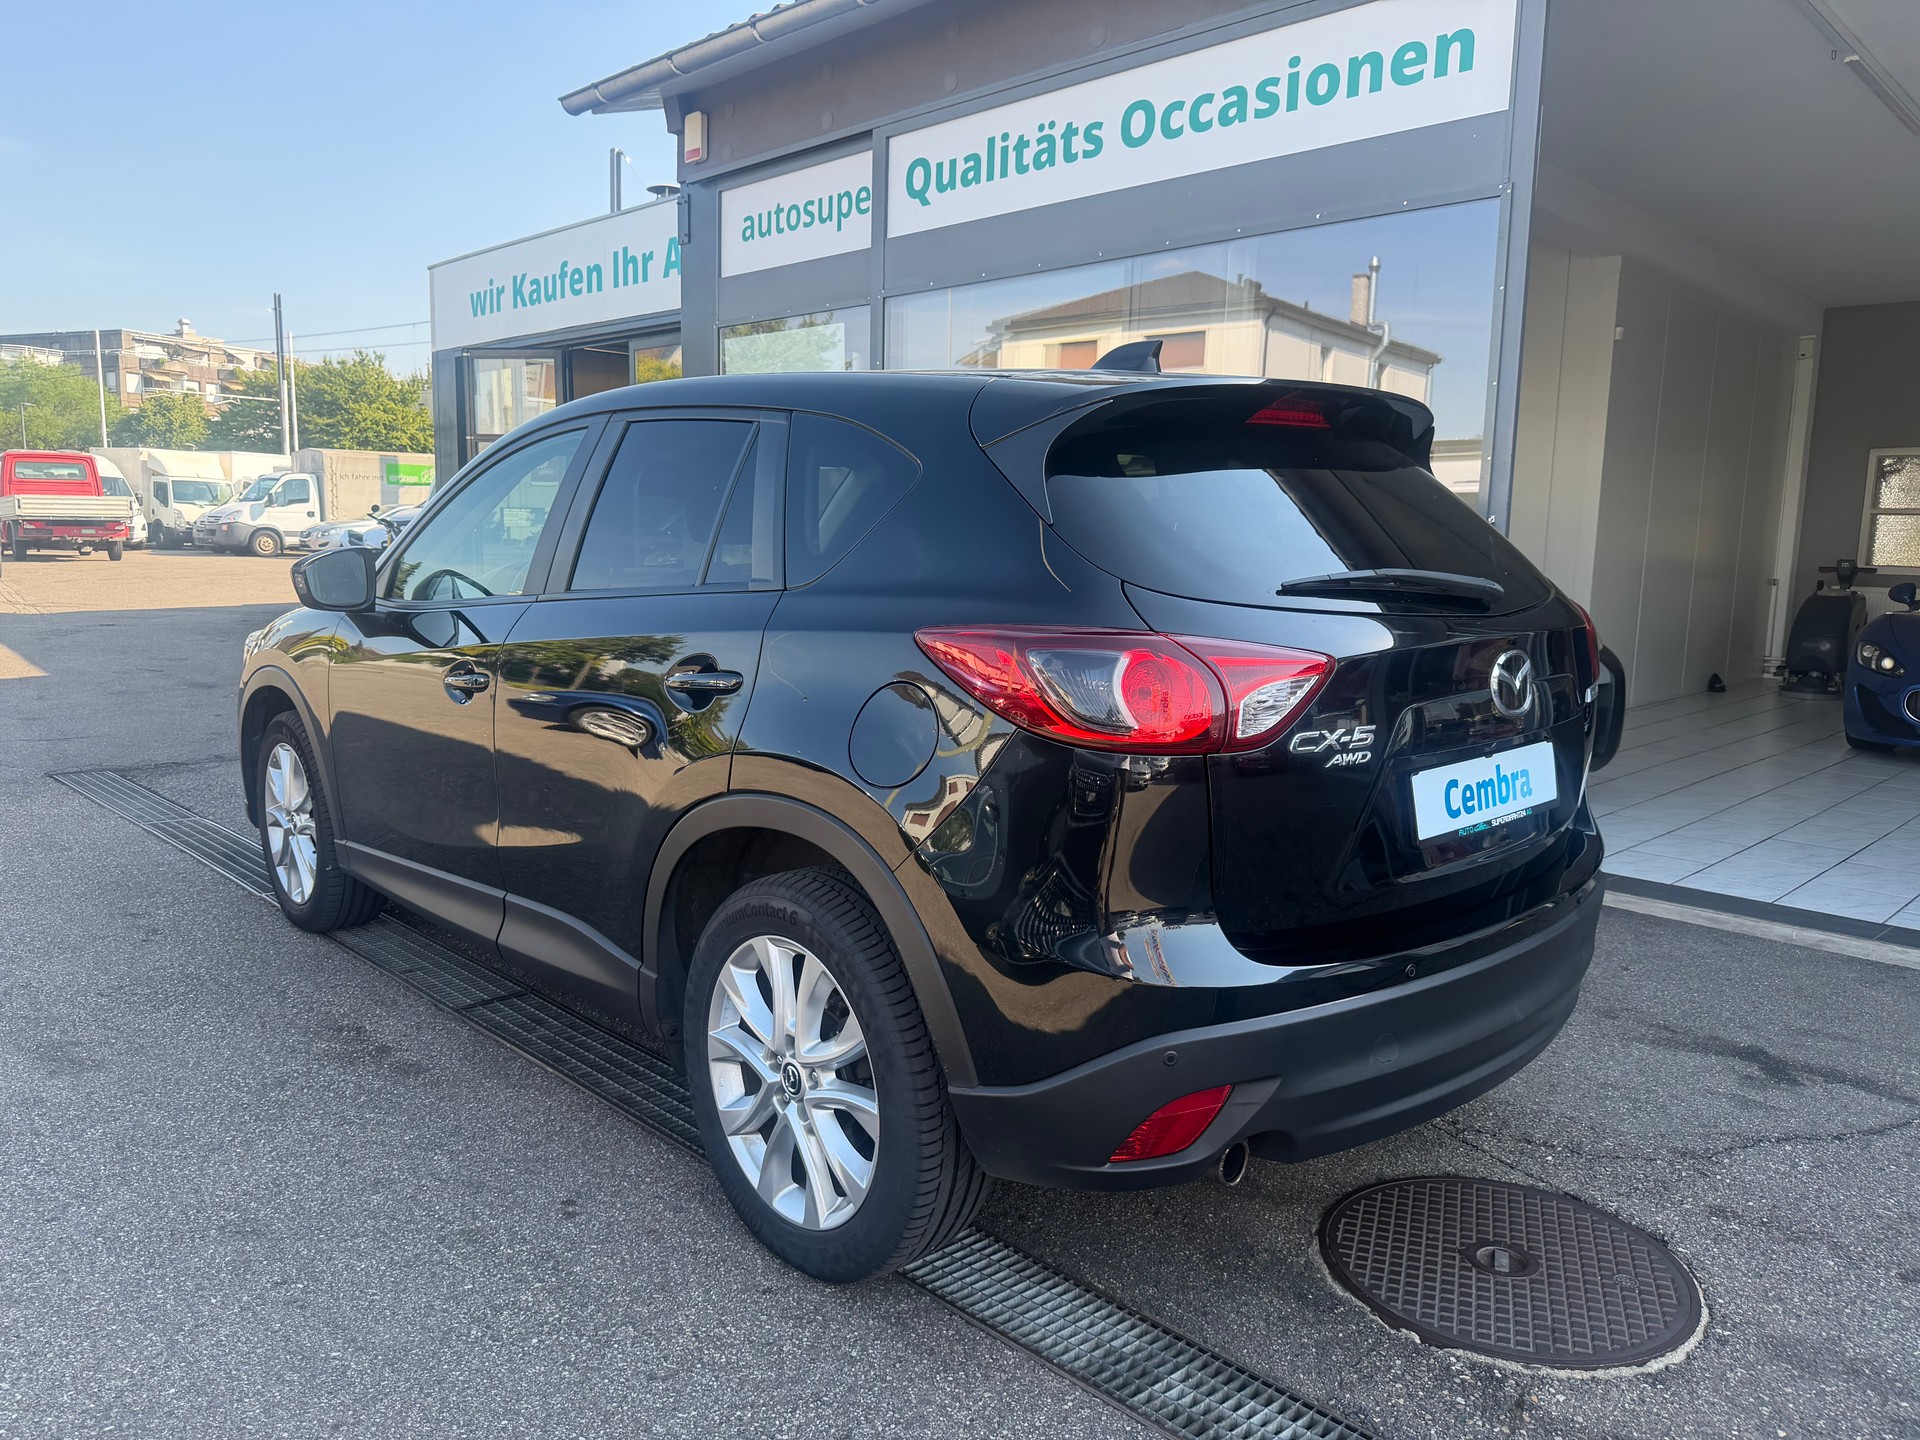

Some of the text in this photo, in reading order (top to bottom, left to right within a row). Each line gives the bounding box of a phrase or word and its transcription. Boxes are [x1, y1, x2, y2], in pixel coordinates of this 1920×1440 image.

[905, 28, 1475, 207] Qualitäts Occasionen
[741, 185, 872, 242] autosupe
[470, 278, 505, 318] wir
[512, 260, 603, 309] Kaufen
[612, 246, 654, 288] Ihr
[340, 472, 350, 480] Ich
[351, 472, 371, 481] fahre
[372, 473, 385, 481] mit
[1289, 725, 1377, 754] CX-5
[1325, 751, 1372, 768] AWD
[1444, 763, 1533, 819] Cembra
[1458, 826, 1474, 837] AUTO
[789, 910, 798, 926] 6
